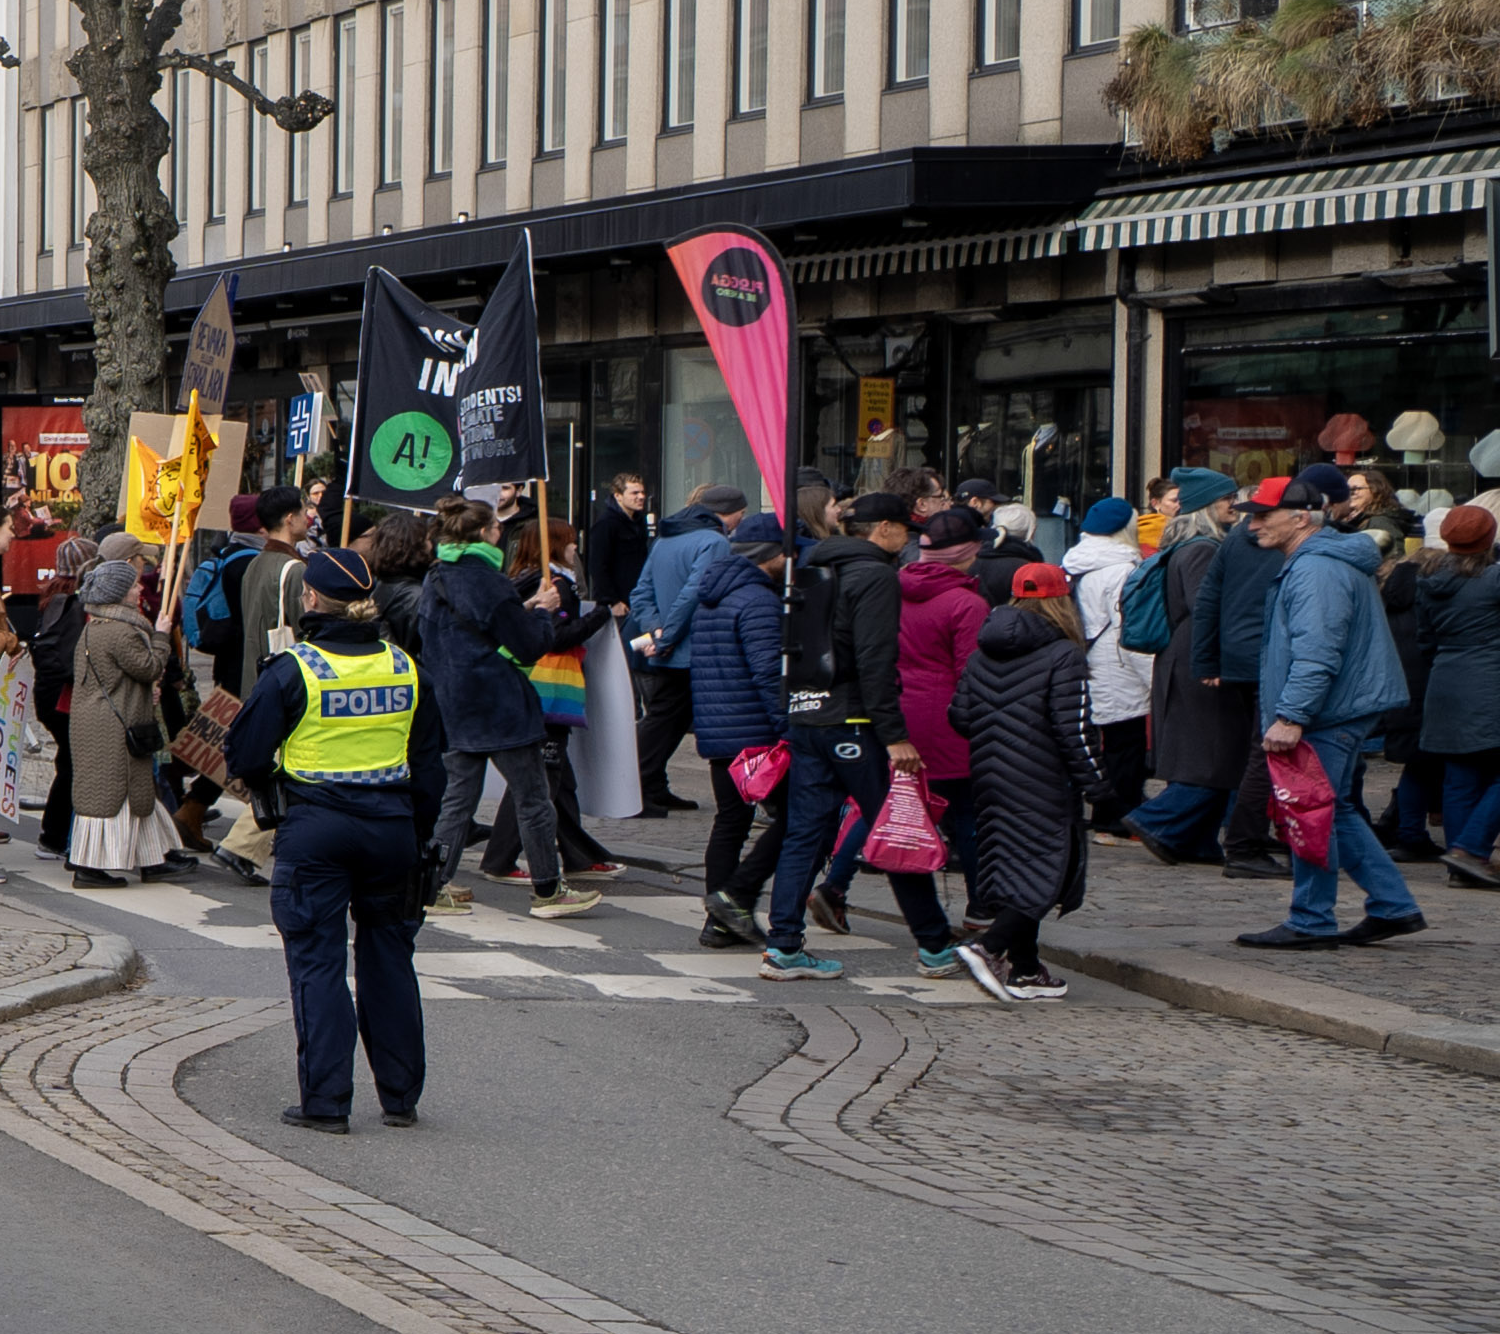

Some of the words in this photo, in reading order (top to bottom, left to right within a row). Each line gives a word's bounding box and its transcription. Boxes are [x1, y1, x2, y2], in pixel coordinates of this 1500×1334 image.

[392, 432, 431, 469] A!
[29, 452, 79, 491] 10
[328, 687, 408, 715] POLIS
[0, 681, 29, 818] REFUGEES
[170, 732, 224, 776] INTE
